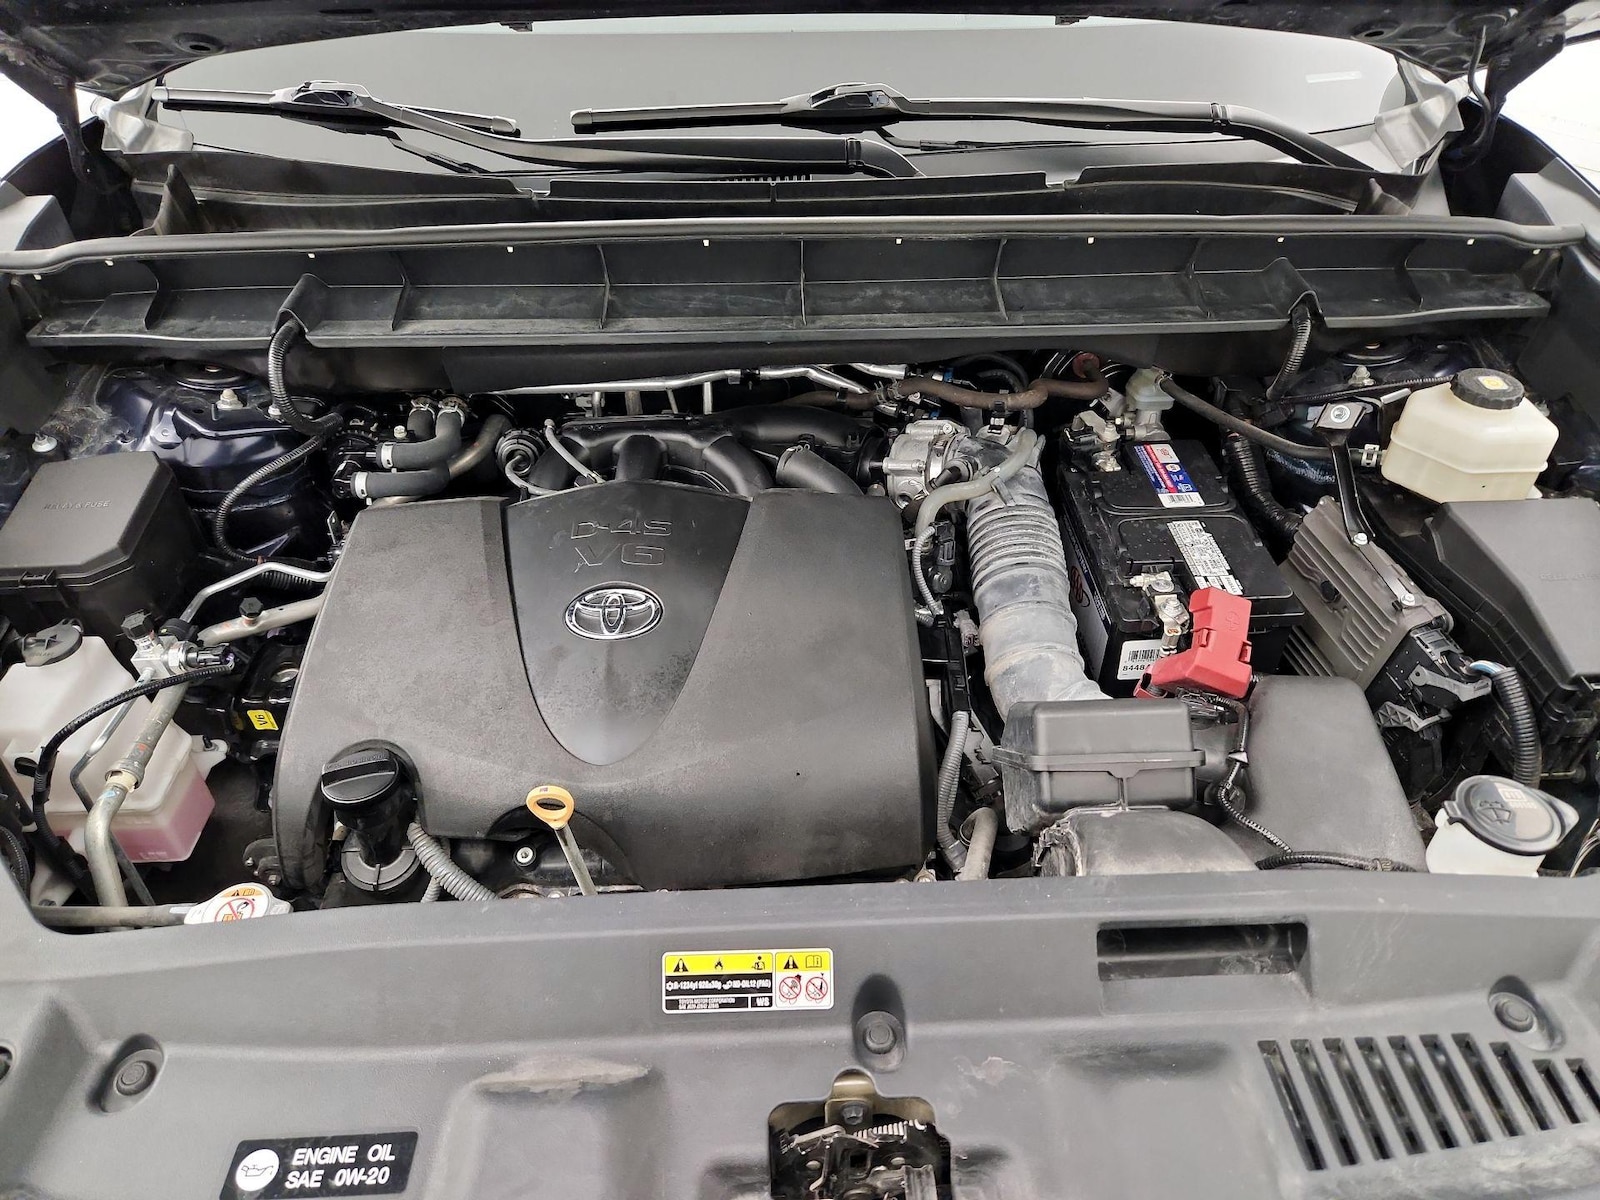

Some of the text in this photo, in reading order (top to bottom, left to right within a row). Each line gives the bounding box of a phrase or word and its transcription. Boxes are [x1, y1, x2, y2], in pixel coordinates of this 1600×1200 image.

[574, 542, 666, 567] V6
[291, 1144, 396, 1166] ENGINE OIL
[284, 1166, 391, 1190] SAE 0W-20
